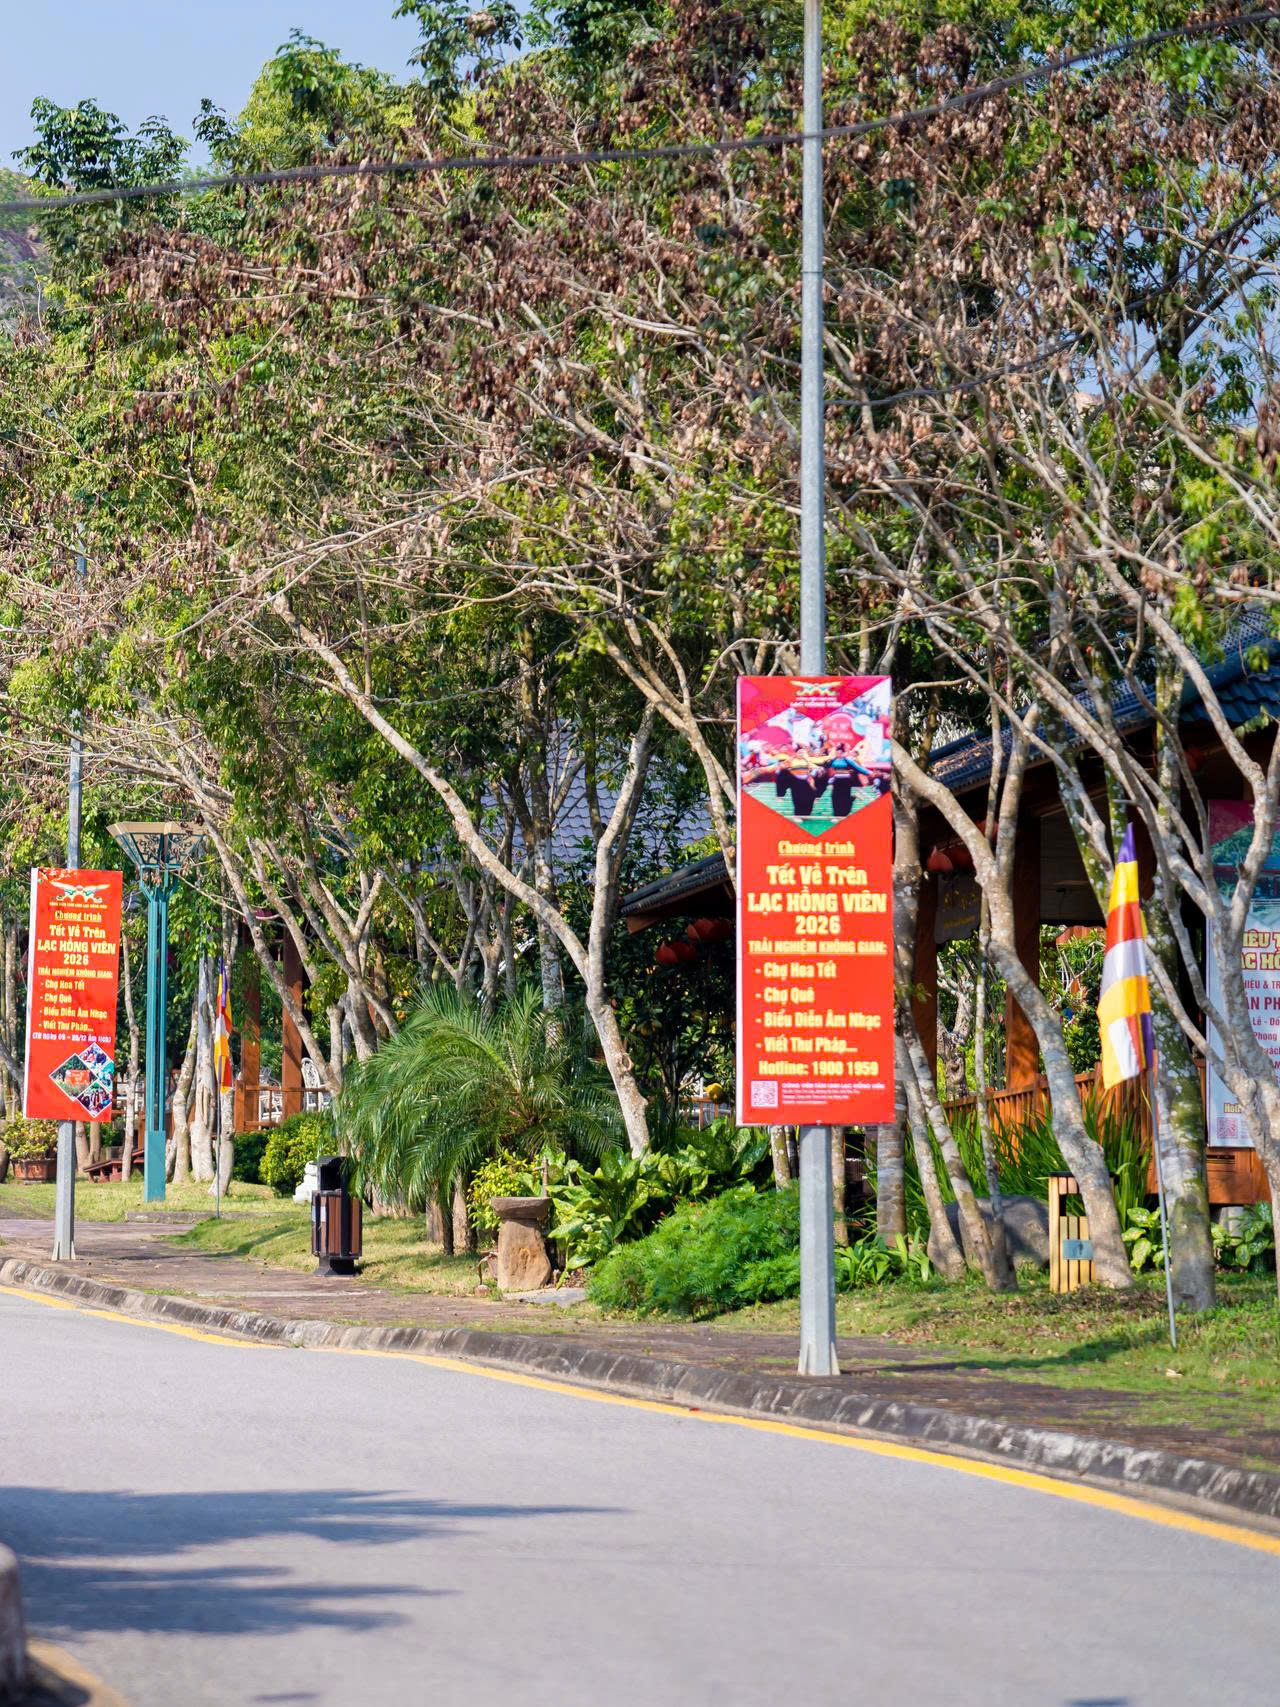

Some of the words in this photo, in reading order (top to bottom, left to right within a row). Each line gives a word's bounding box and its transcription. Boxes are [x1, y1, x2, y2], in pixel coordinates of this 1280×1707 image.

[778, 840, 822, 857] Chương
[825, 841, 855, 856] trình
[766, 862, 796, 885] Tết
[799, 862, 822, 885] Về
[825, 865, 868, 885] Trên
[747, 892, 782, 915] LẠC
[786, 885, 838, 912] HỒNG
[842, 889, 887, 913] VIÊN
[49, 923, 65, 936] Tết
[67, 924, 80, 937] Về
[82, 926, 106, 938] Trên
[795, 915, 841, 935] 2026
[37, 939, 57, 952] LẠC
[59, 937, 88, 953] HỒNG
[91, 940, 116, 955] VIÊN
[63, 953, 89, 965] 2026
[763, 962, 788, 980] Chợ
[790, 962, 814, 978] Hoa
[816, 960, 837, 978] Tết
[763, 987, 788, 1005] Chợ
[790, 986, 815, 1004] Quê
[764, 1008, 792, 1027] Biểu
[794, 1009, 823, 1027] Diễn
[825, 1008, 846, 1027] Âm
[848, 1012, 881, 1031] Nhạc
[764, 1034, 788, 1052] Viết
[790, 1037, 813, 1052] Thư
[758, 1060, 809, 1075] Hotline:
[847, 1061, 879, 1076] 1959
